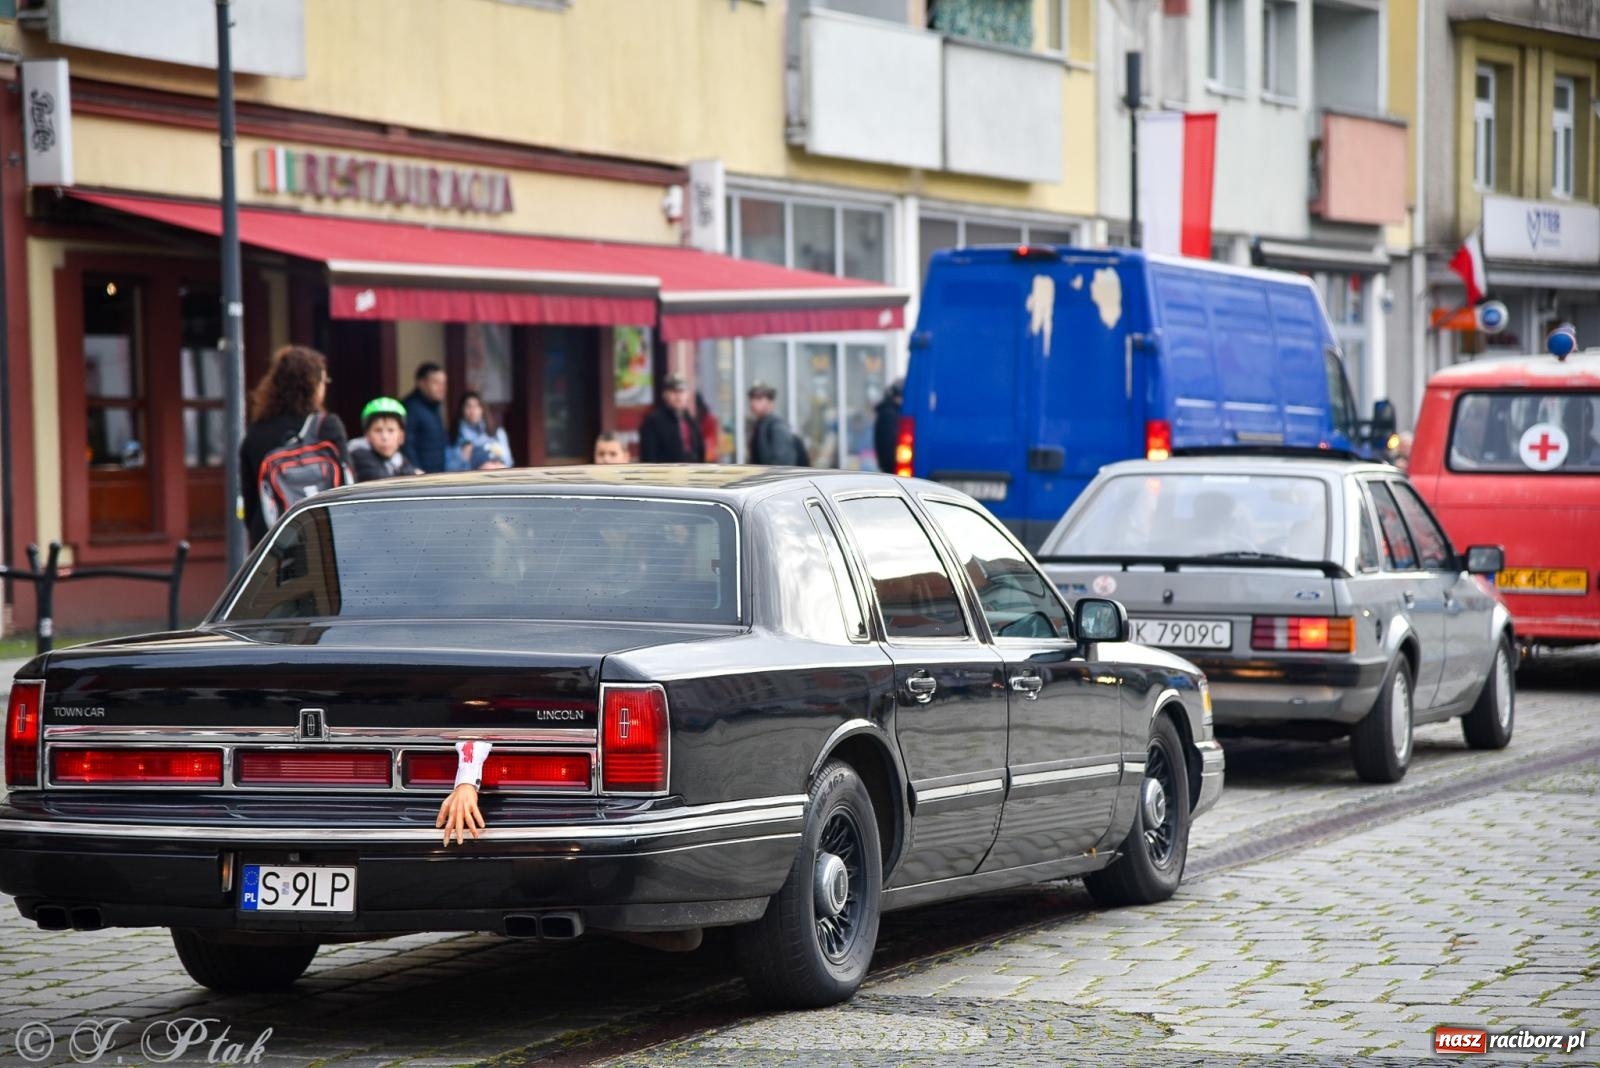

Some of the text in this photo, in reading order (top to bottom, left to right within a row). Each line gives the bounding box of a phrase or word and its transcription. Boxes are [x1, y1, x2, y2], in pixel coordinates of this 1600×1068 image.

[1157, 623, 1224, 645] 7909C
[53, 706, 105, 717] TOWN CAR
[536, 709, 584, 720] LINCOLN
[261, 871, 350, 907] S 9LP
[244, 892, 257, 903] PL
